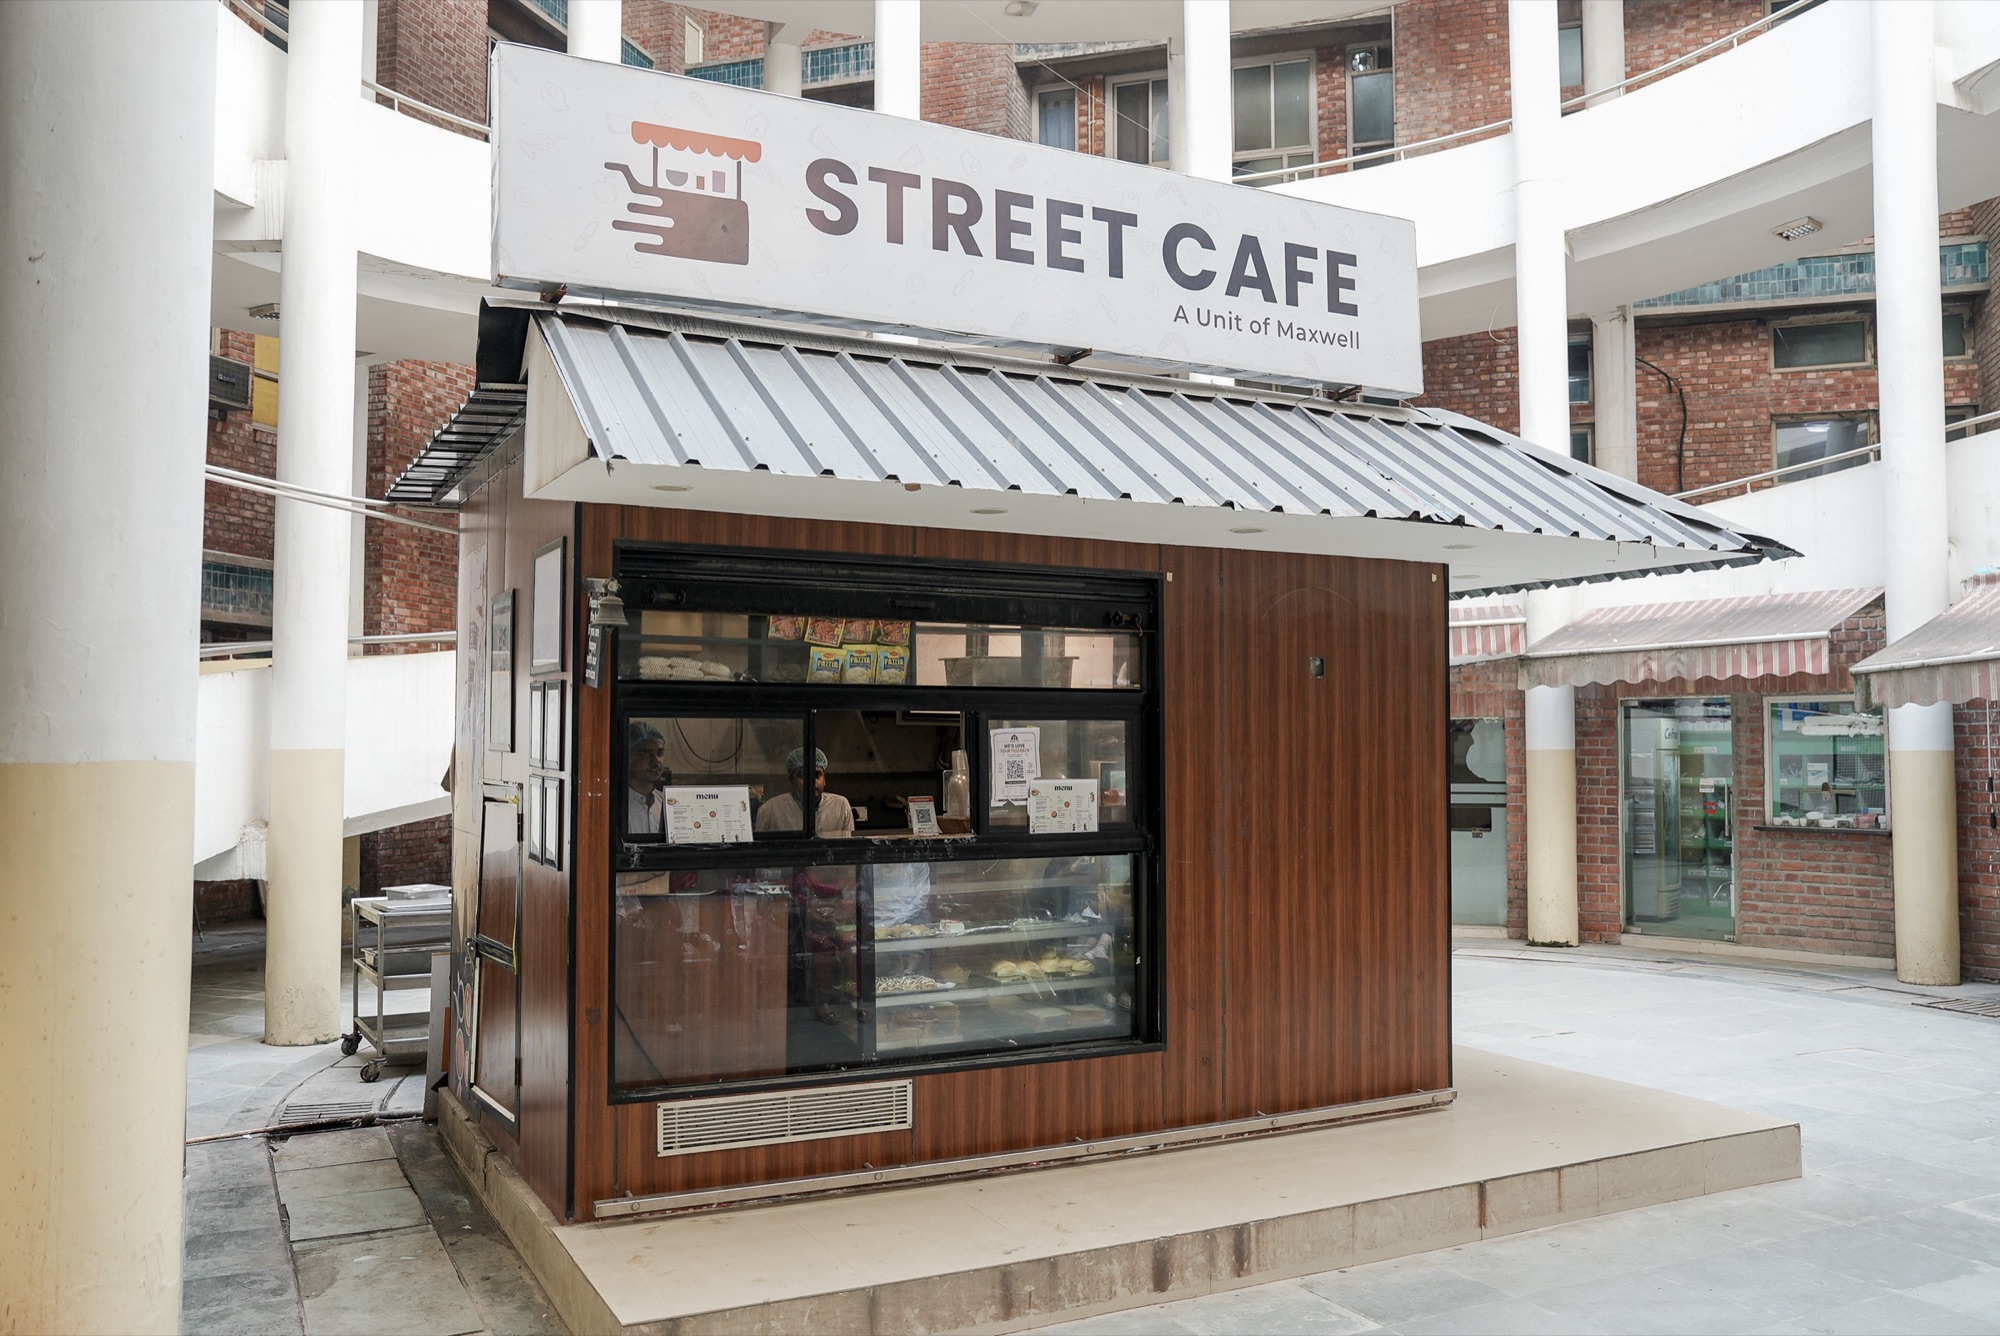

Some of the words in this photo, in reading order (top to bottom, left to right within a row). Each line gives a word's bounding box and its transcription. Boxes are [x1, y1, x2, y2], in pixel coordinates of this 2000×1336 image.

[805, 158, 1138, 279] STREET
[1162, 222, 1359, 317] CAFE
[1173, 304, 1189, 324] A
[1196, 307, 1243, 332] Unit
[1249, 317, 1271, 336] of
[1277, 319, 1360, 350] Maxwell
